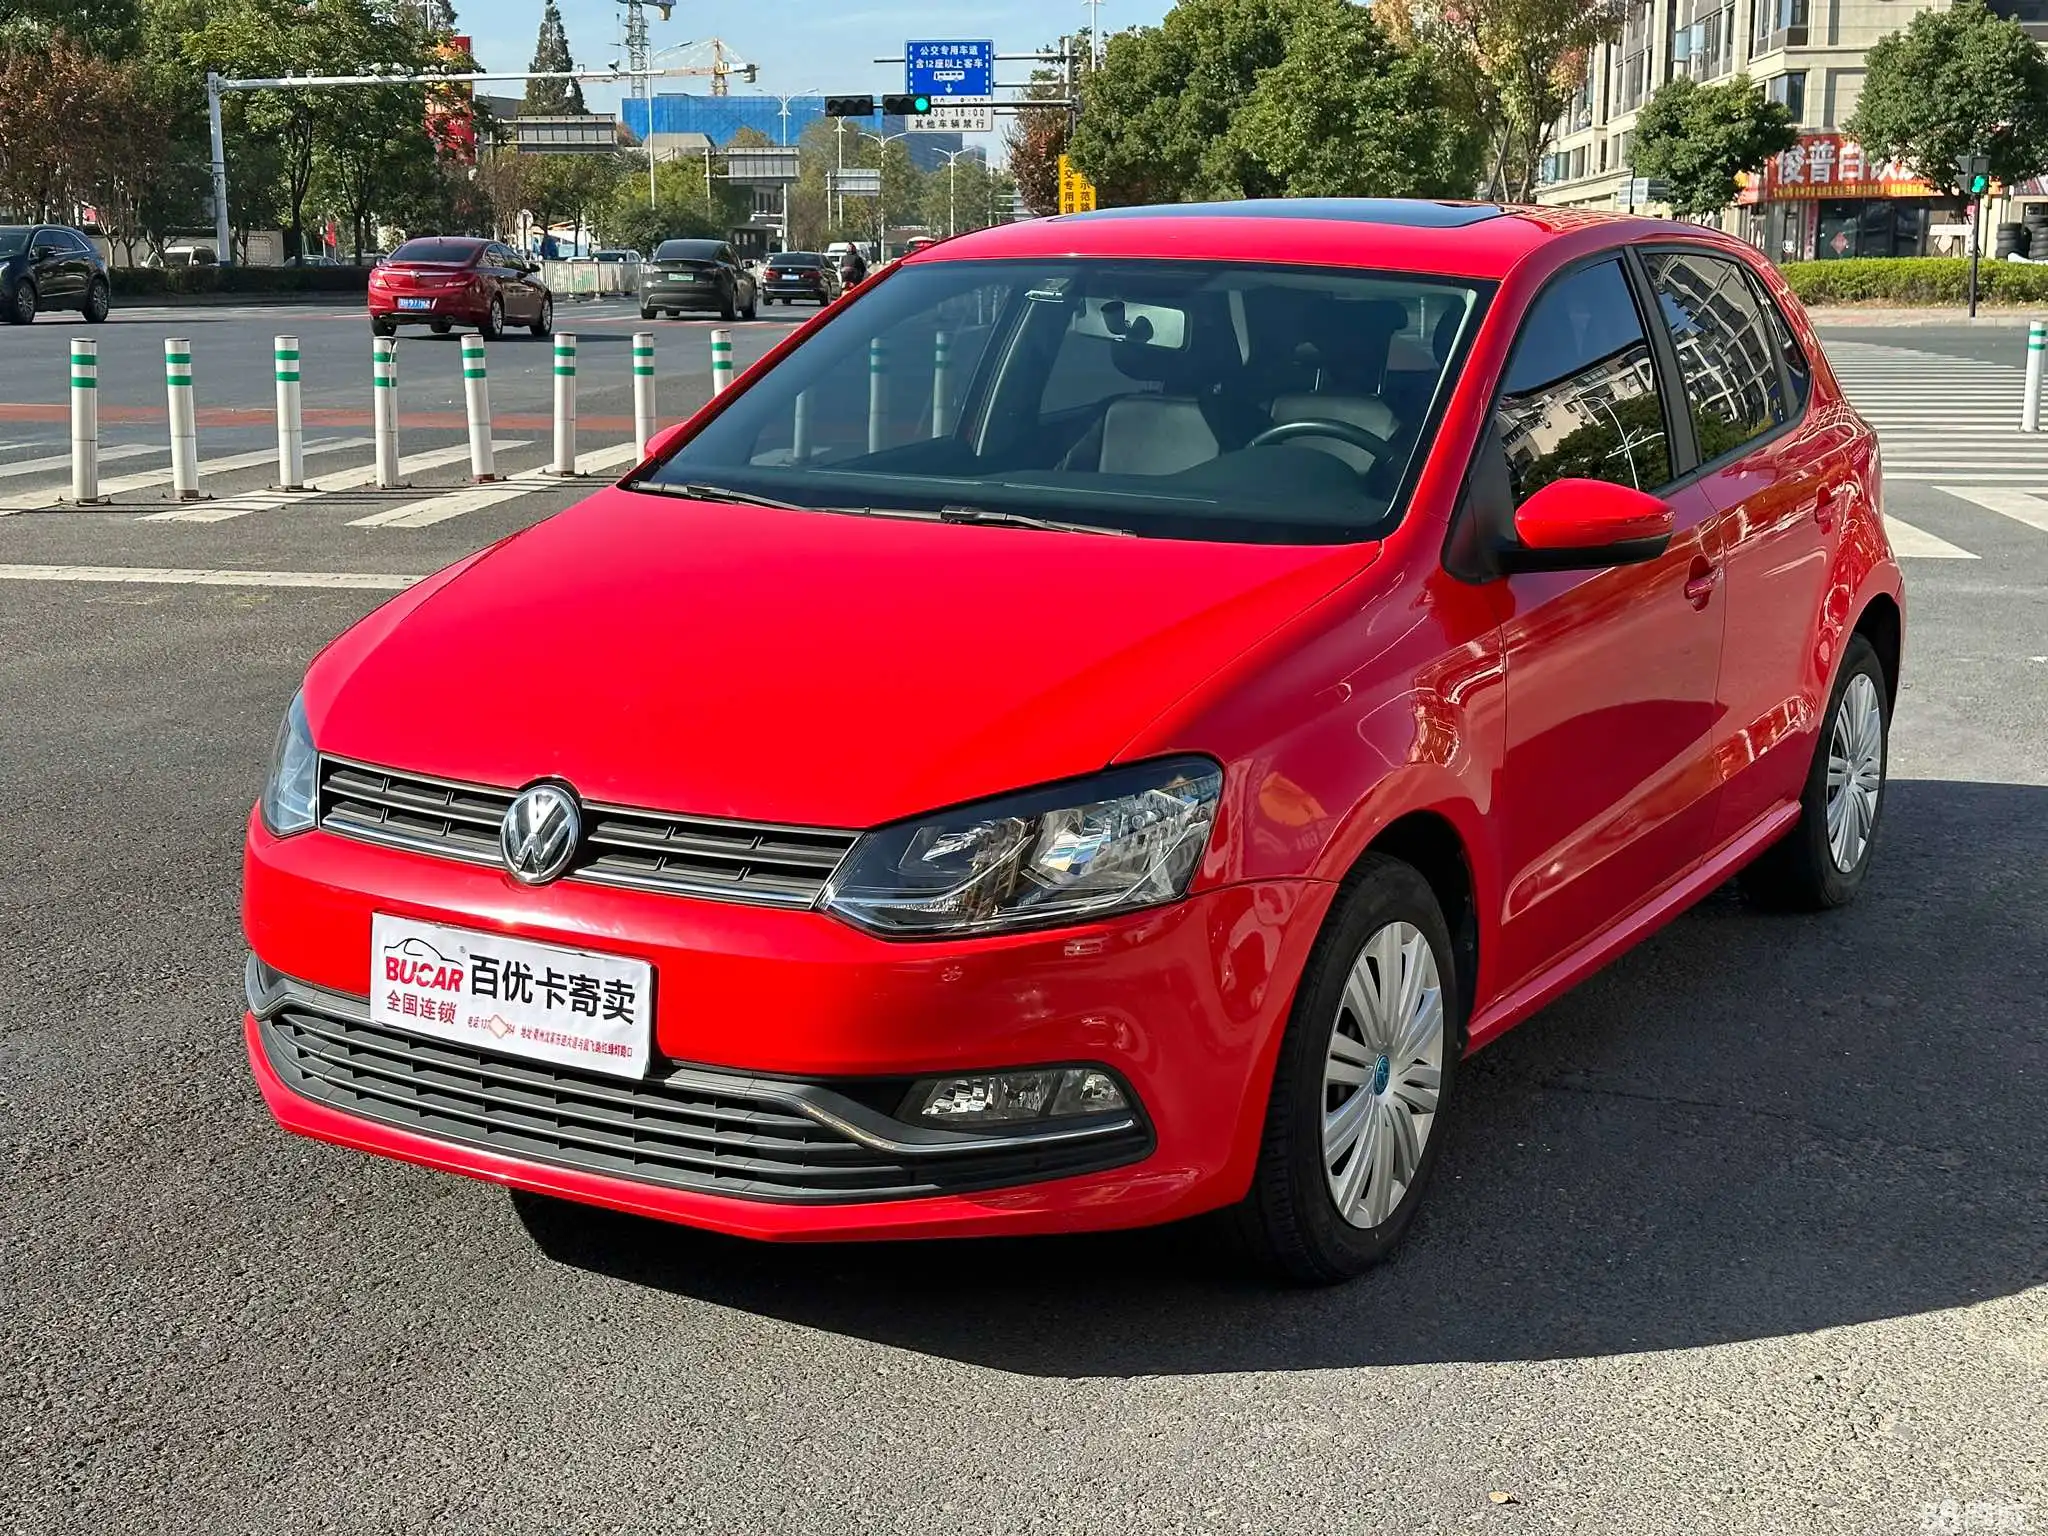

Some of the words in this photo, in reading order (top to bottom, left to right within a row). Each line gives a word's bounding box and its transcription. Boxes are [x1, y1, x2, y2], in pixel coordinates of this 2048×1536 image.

[920, 45, 978, 56] 公交专用车道
[915, 119, 985, 129] 其他车辆禁行
[385, 956, 464, 992] BUCAR
[469, 954, 635, 1025] 百优卡寄卖
[387, 989, 457, 1024] 全国连锁
